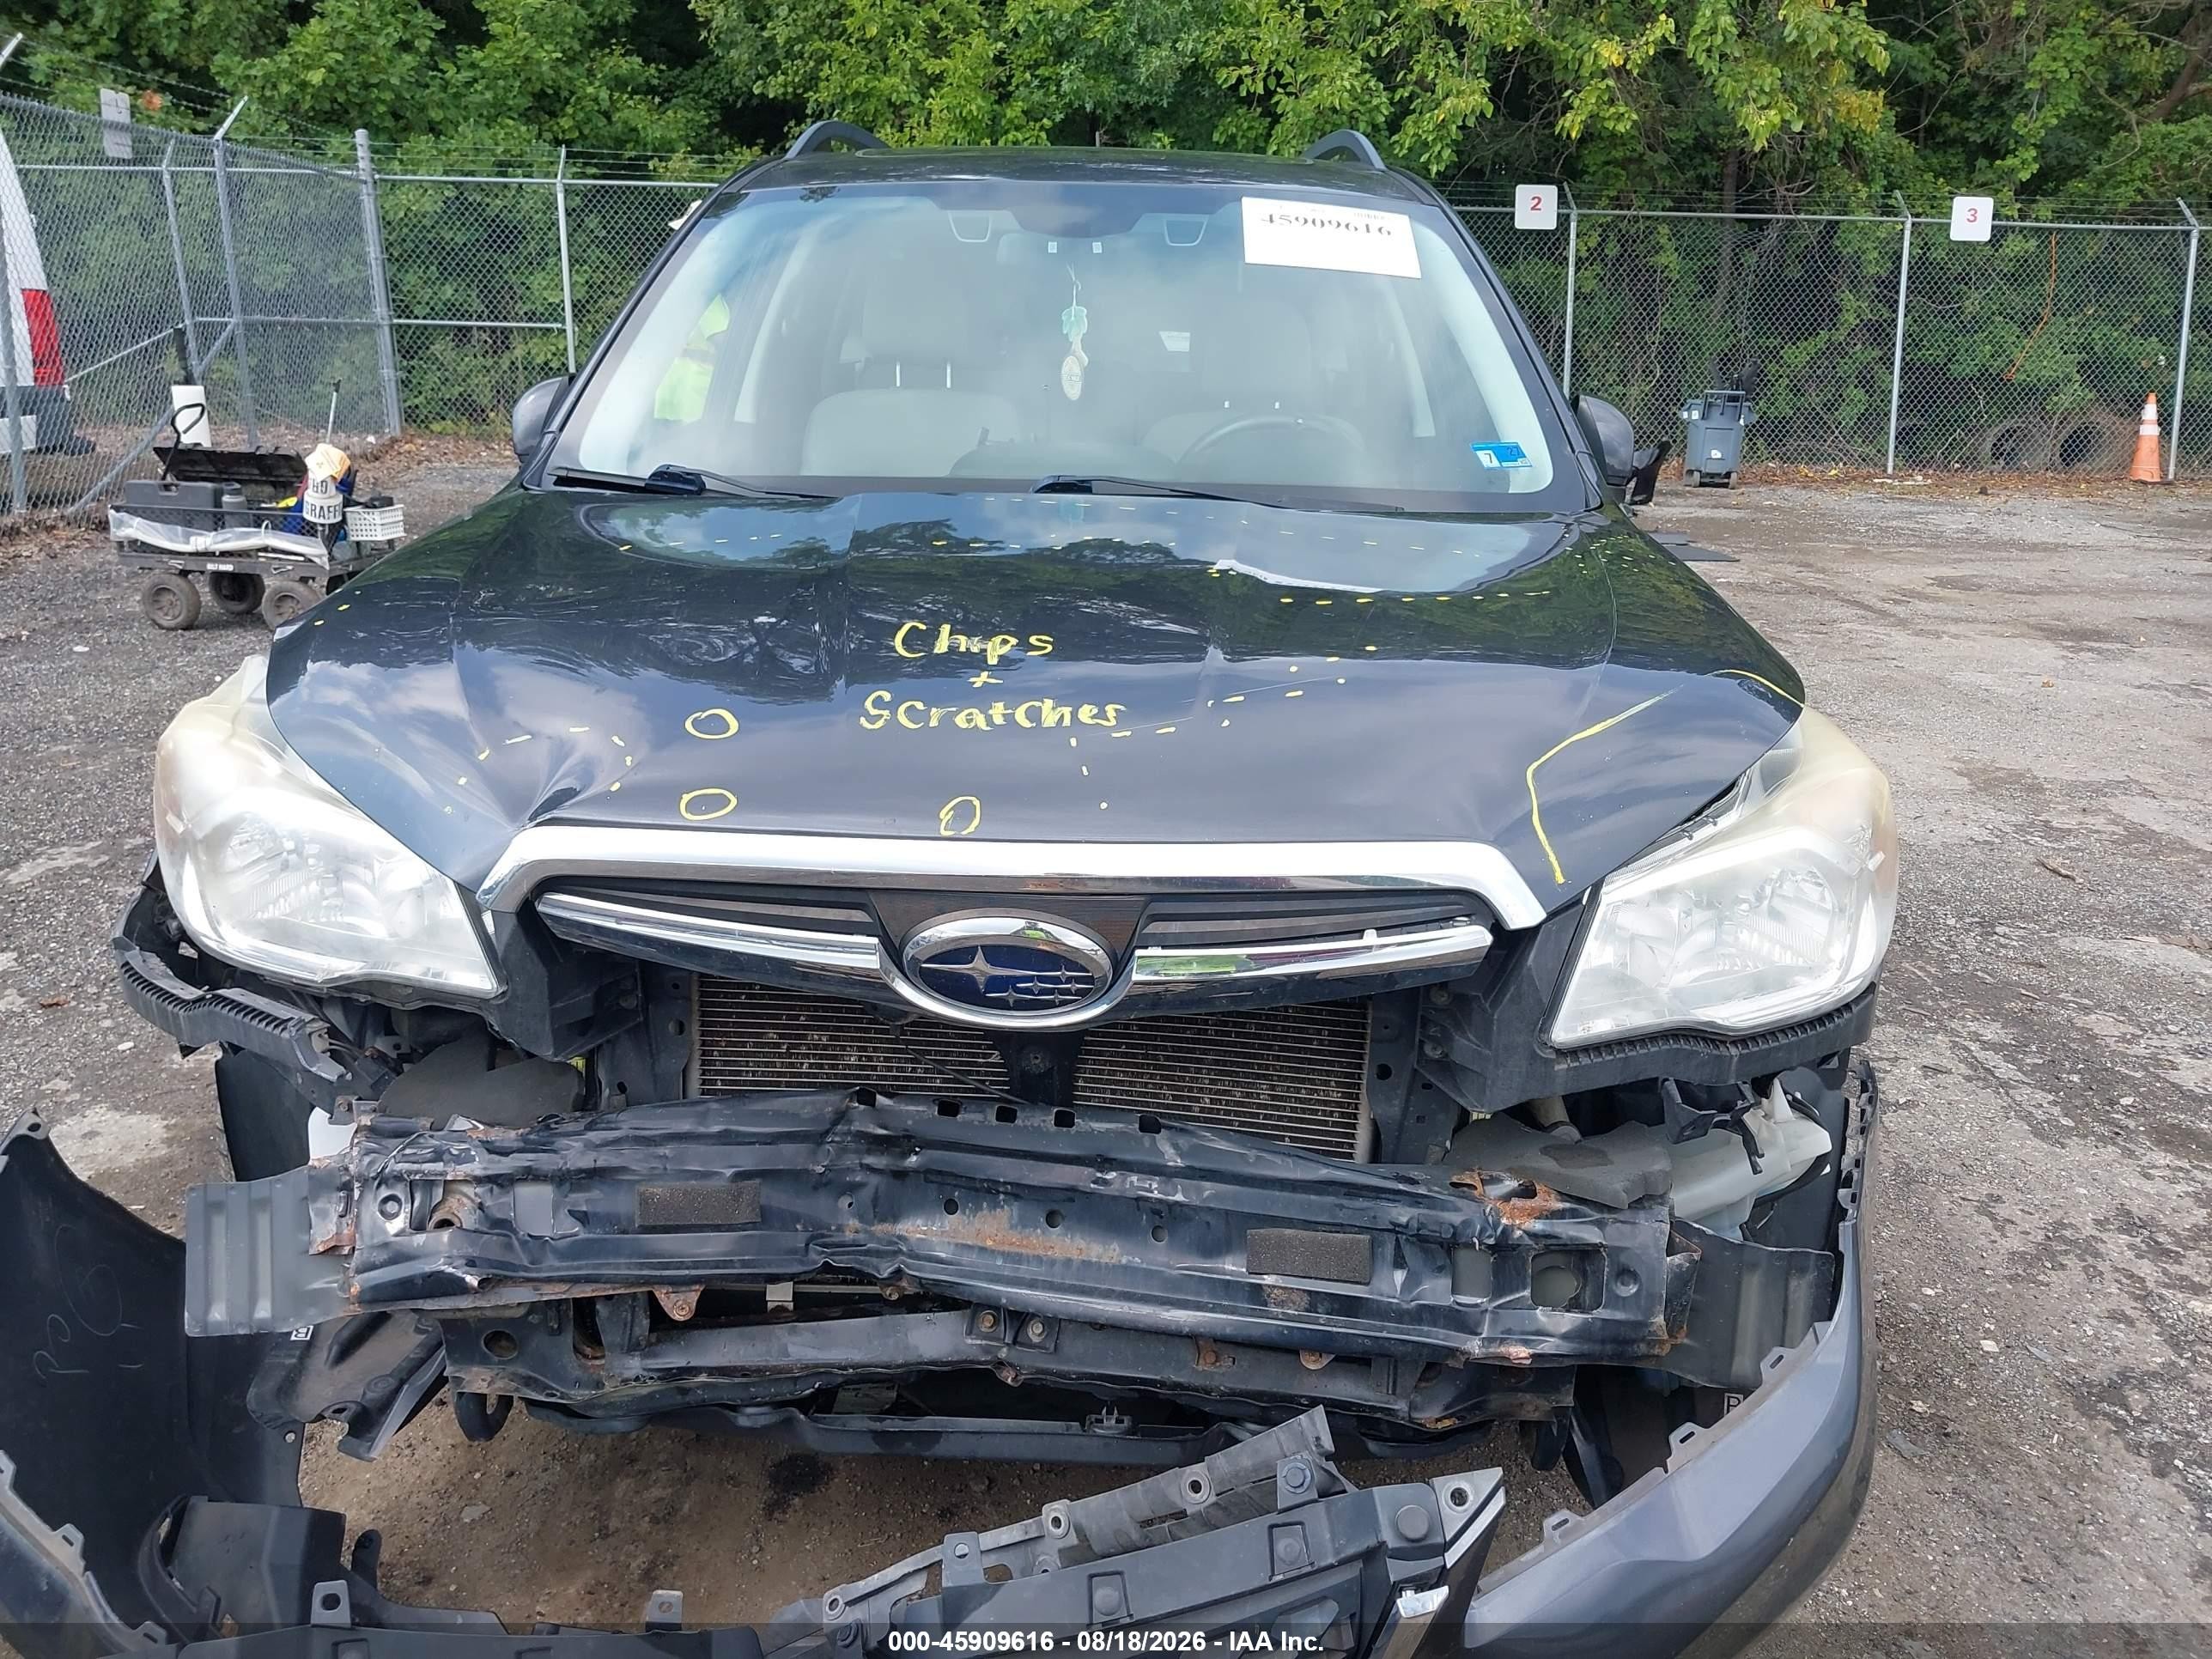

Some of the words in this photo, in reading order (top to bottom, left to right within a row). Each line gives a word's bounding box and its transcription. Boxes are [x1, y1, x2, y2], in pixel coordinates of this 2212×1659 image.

[1531, 196, 1541, 210] 2
[1966, 208, 1978, 222] 3
[1261, 213, 1392, 236] 45909616
[1484, 453, 1493, 464] 7
